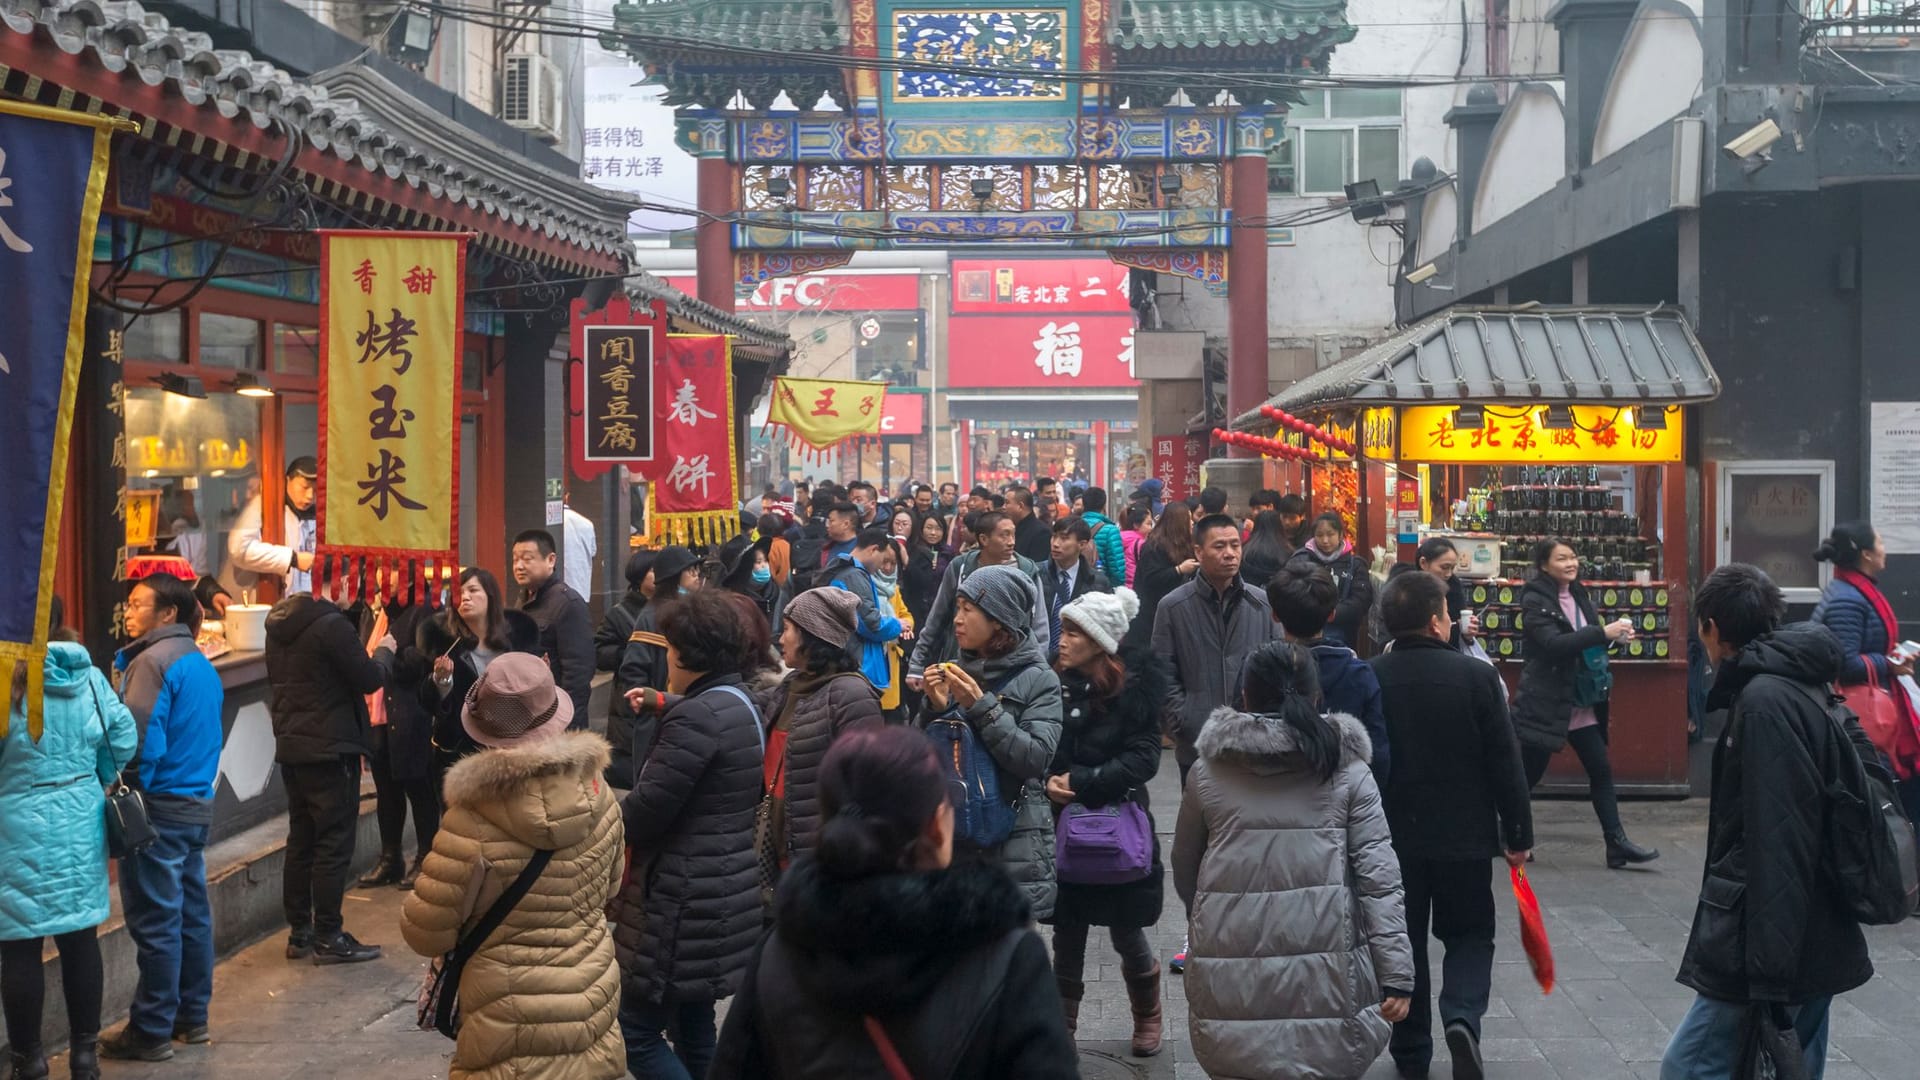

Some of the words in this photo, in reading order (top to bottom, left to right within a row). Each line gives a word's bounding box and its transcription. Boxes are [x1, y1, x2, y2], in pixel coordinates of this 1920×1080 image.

[584, 127, 644, 148] 睡得饱
[584, 156, 664, 177] 满有光泽
[356, 308, 428, 521] 烤玉米
[665, 378, 718, 499] 春饼
